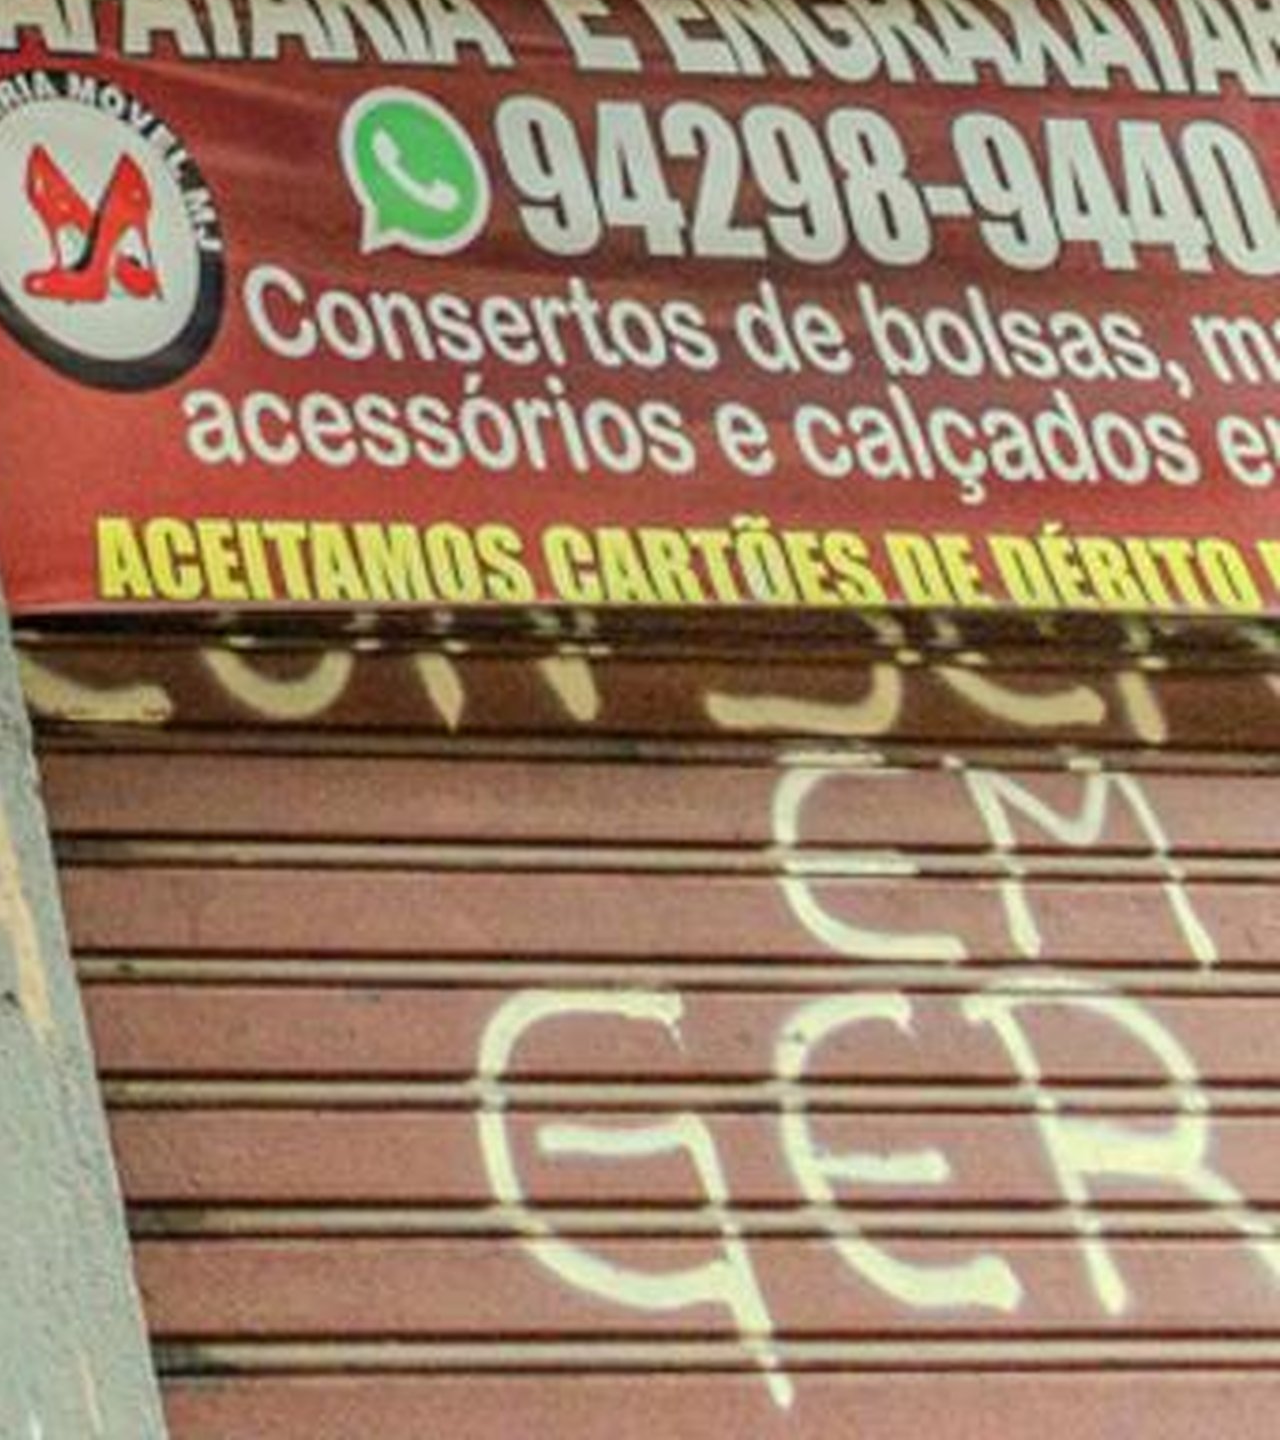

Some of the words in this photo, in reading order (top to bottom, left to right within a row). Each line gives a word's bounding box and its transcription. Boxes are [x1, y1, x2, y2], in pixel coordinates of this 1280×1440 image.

[494, 95, 1280, 277] 94298-9440
[243, 264, 719, 369] Consertos
[736, 279, 853, 374] de
[857, 282, 1192, 399] bolsas,
[181, 373, 696, 474] acessórios
[714, 402, 776, 476] e
[793, 383, 1201, 505] calçados
[95, 515, 538, 602] ACEITAMOS
[543, 514, 885, 606] CARTÕES
[885, 530, 990, 608] DE
[987, 521, 1264, 610] DÉBITO
